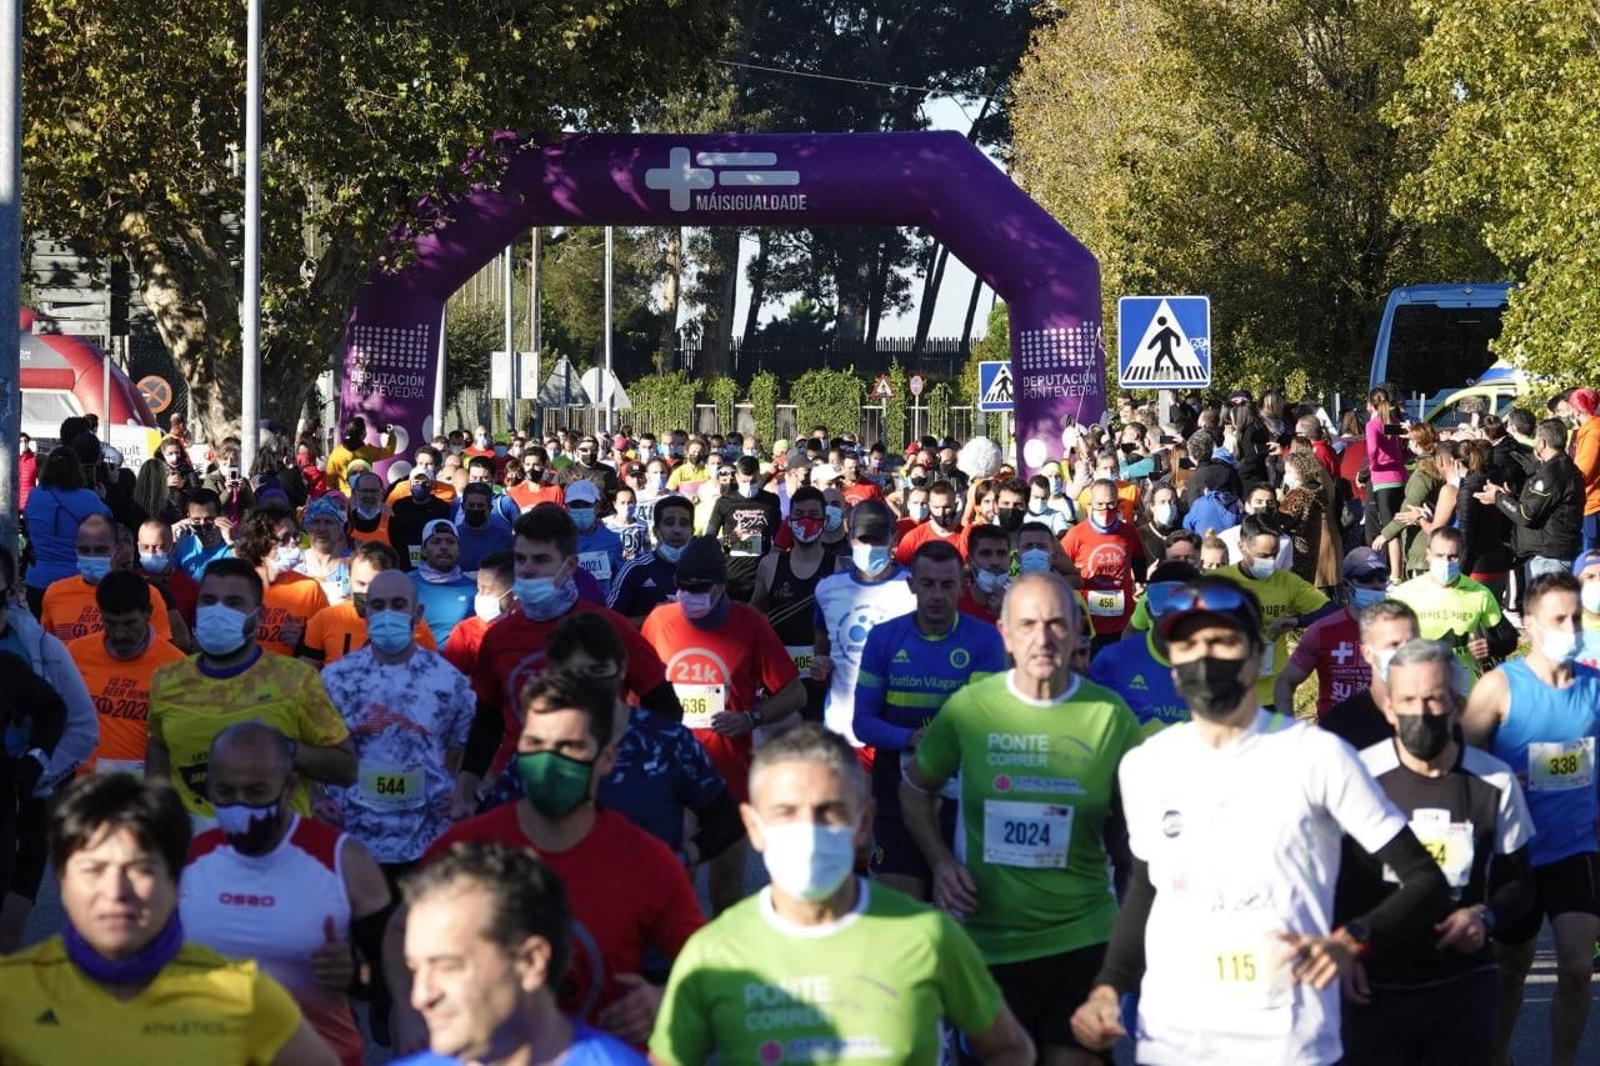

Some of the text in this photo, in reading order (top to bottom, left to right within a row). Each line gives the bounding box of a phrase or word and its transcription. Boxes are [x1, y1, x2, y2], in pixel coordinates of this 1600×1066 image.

[350, 370, 425, 387] DEPUTACIÓN
[1023, 369, 1097, 387] DEPUTACIÓN
[350, 383, 424, 398] PONTEVEDRA
[1023, 385, 1098, 399] PONTEVEDRA
[677, 661, 717, 683] 21k
[682, 698, 707, 714] 636
[988, 732, 1050, 753] PONTE
[988, 752, 1049, 768] CORRER
[1550, 755, 1577, 776] 338
[377, 775, 405, 796] 544
[1004, 820, 1051, 847] 2024
[1217, 954, 1257, 982] 115
